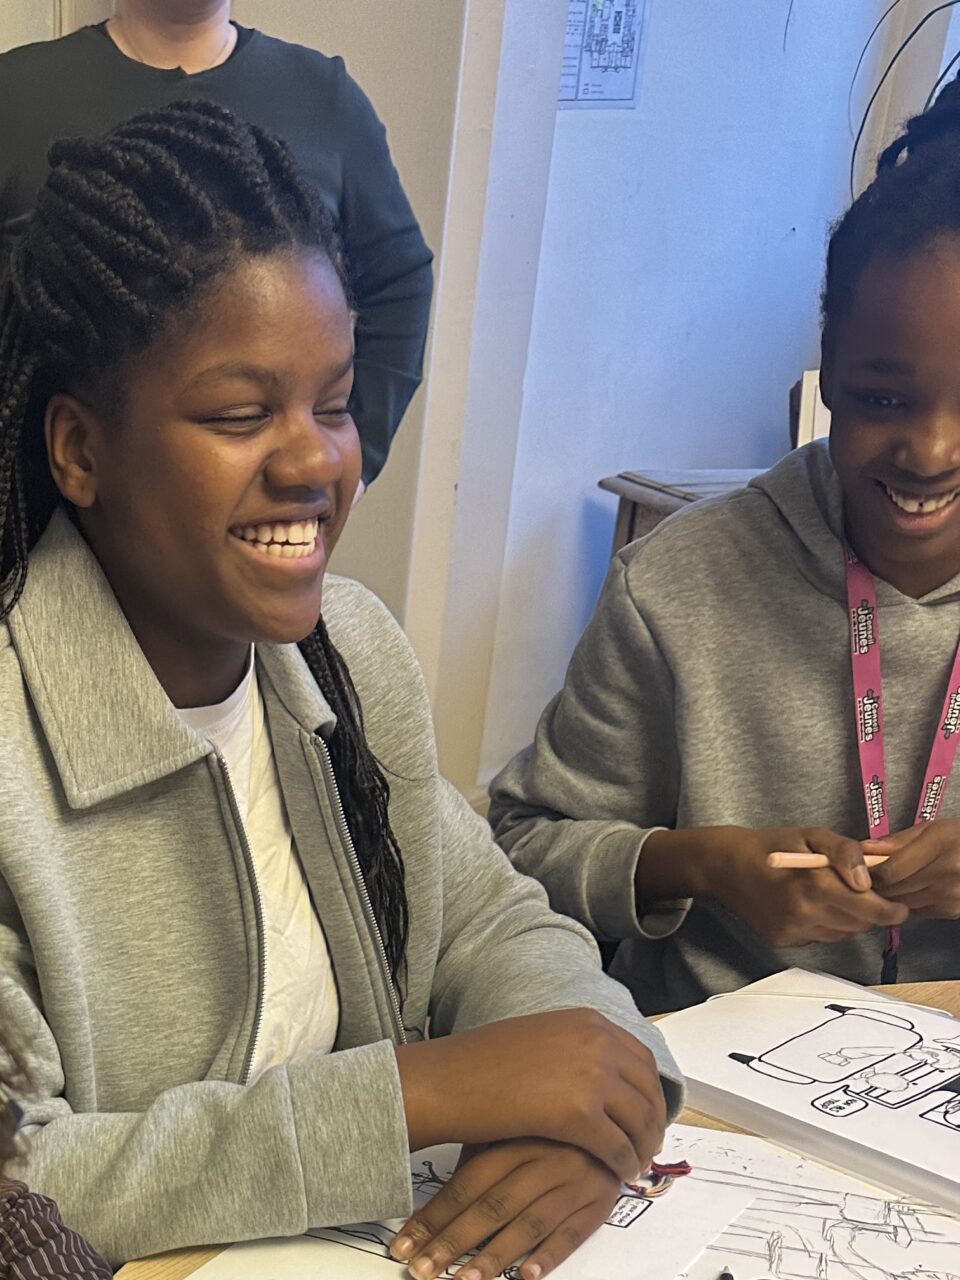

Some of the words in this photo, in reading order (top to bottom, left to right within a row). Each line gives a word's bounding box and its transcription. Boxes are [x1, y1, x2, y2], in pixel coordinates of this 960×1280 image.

[856, 606, 868, 653] Jeunes
[866, 613, 874, 644] Conseil
[862, 696, 873, 741] Jeunes
[871, 702, 879, 732] Conseil
[869, 782, 880, 825] Jeunes
[921, 774, 941, 820] Jeunes
